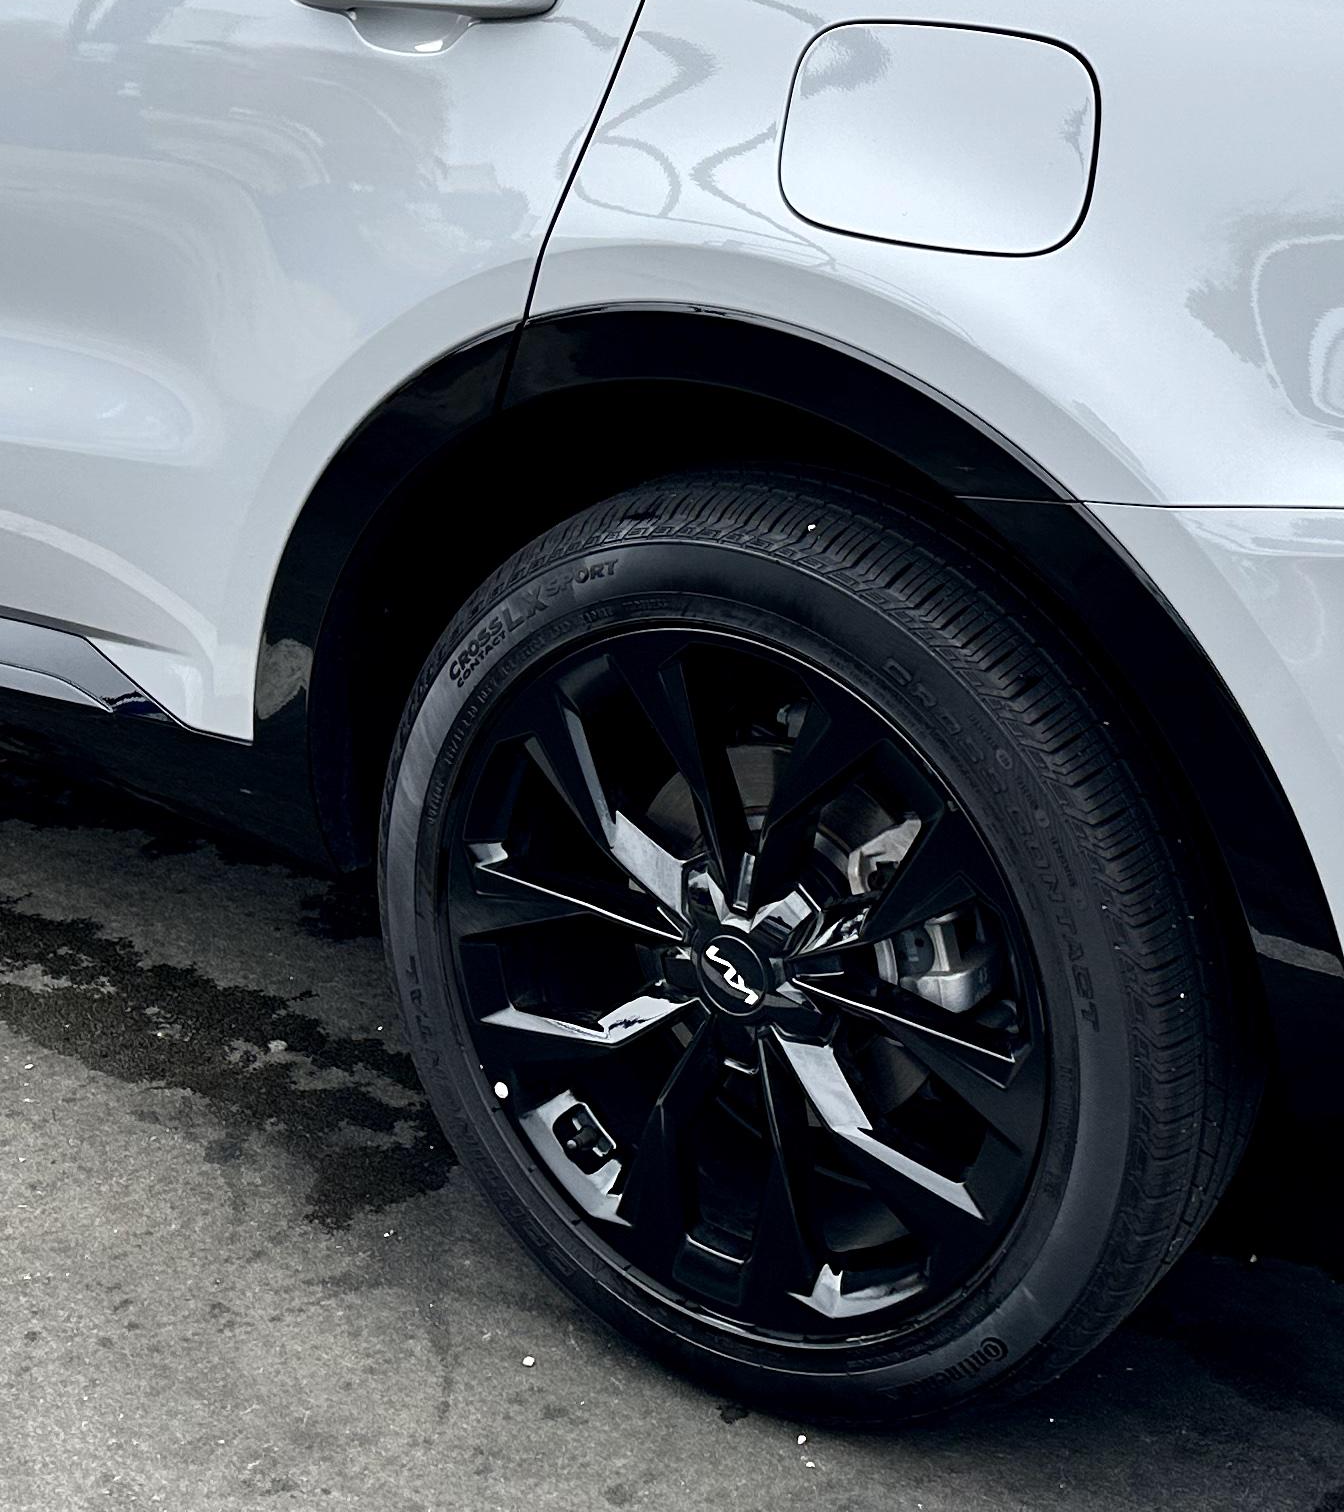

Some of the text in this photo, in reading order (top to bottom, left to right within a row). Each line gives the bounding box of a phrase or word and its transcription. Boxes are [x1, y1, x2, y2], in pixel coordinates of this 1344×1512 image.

[448, 616, 504, 682] CROSS
[543, 558, 620, 598] SPORT
[456, 630, 508, 689] CONTACT
